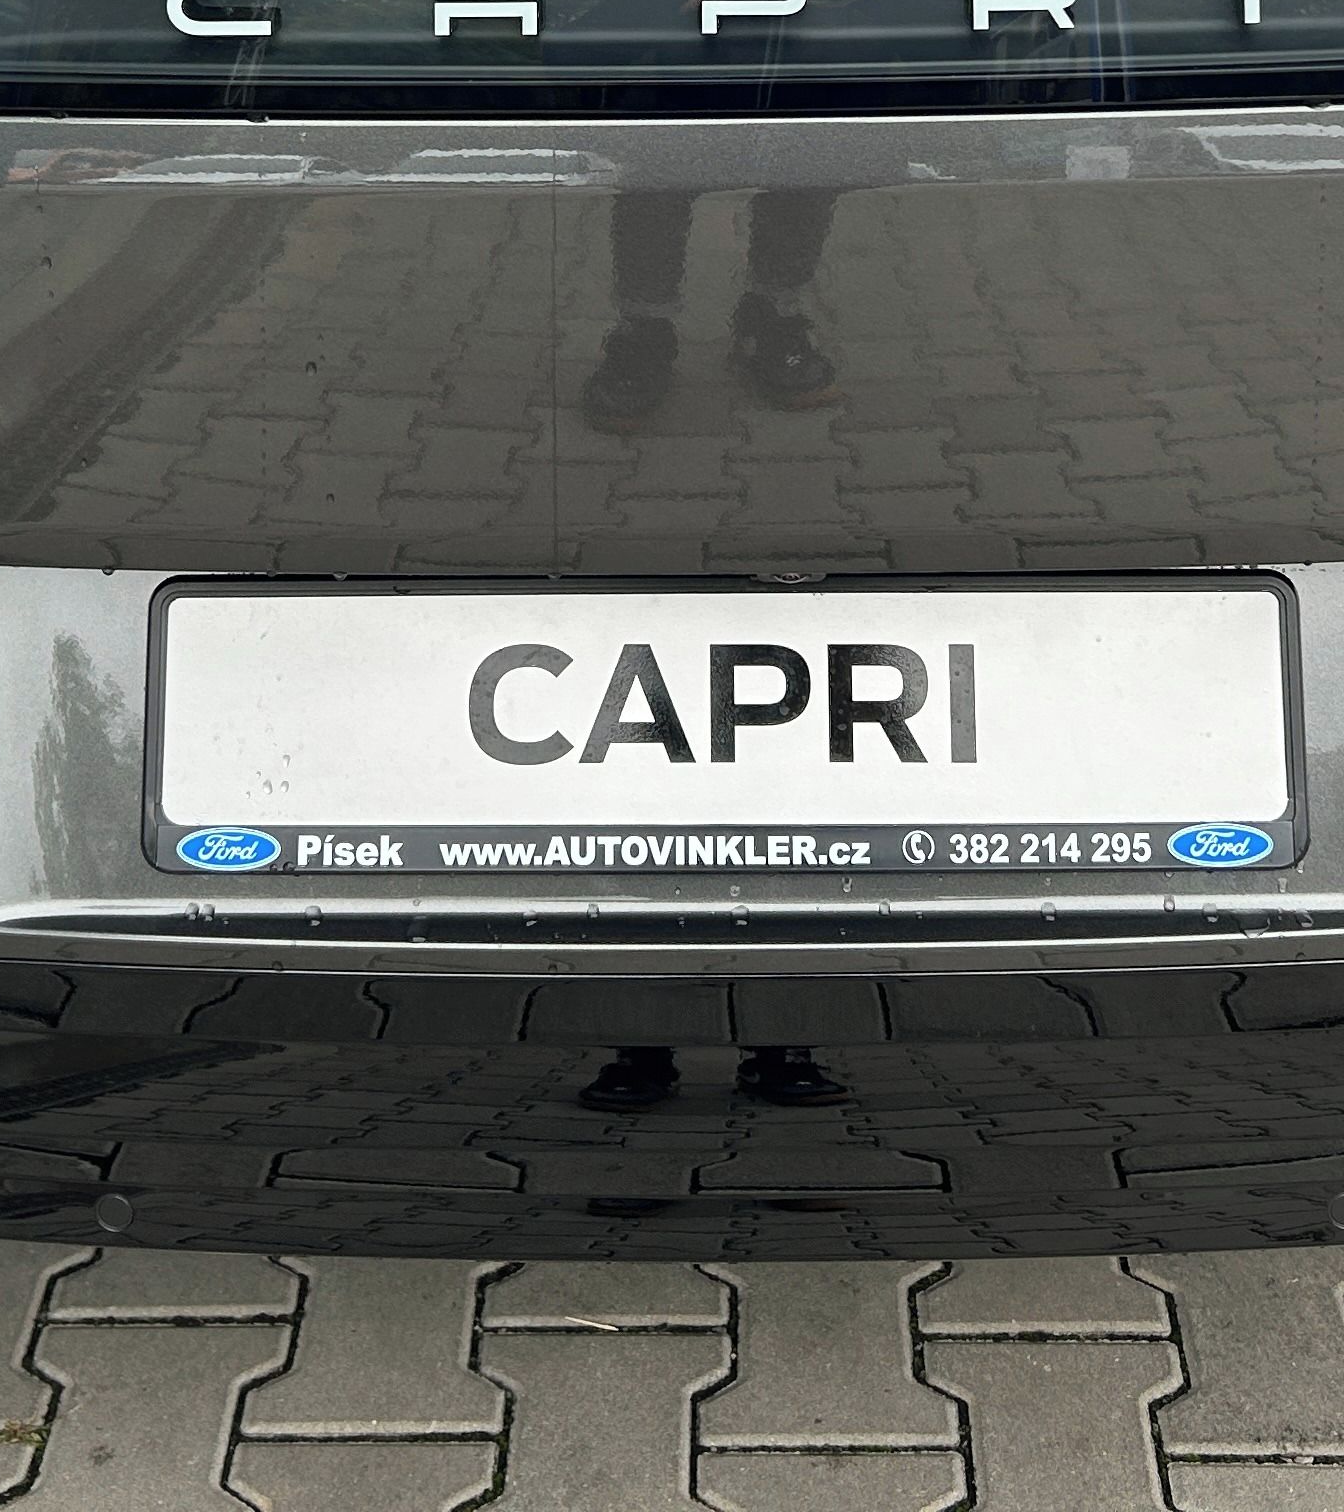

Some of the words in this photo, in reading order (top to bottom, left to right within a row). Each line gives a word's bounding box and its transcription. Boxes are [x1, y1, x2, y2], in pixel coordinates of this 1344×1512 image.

[468, 643, 978, 766] CAPRI
[197, 834, 258, 861] Ford
[297, 834, 404, 867] Písek
[440, 835, 871, 867] www.AUTOVINKLER.cz
[949, 833, 1010, 864] 382
[1020, 833, 1080, 864] 214
[1090, 832, 1152, 863] 295
[1190, 831, 1250, 858] Ford
